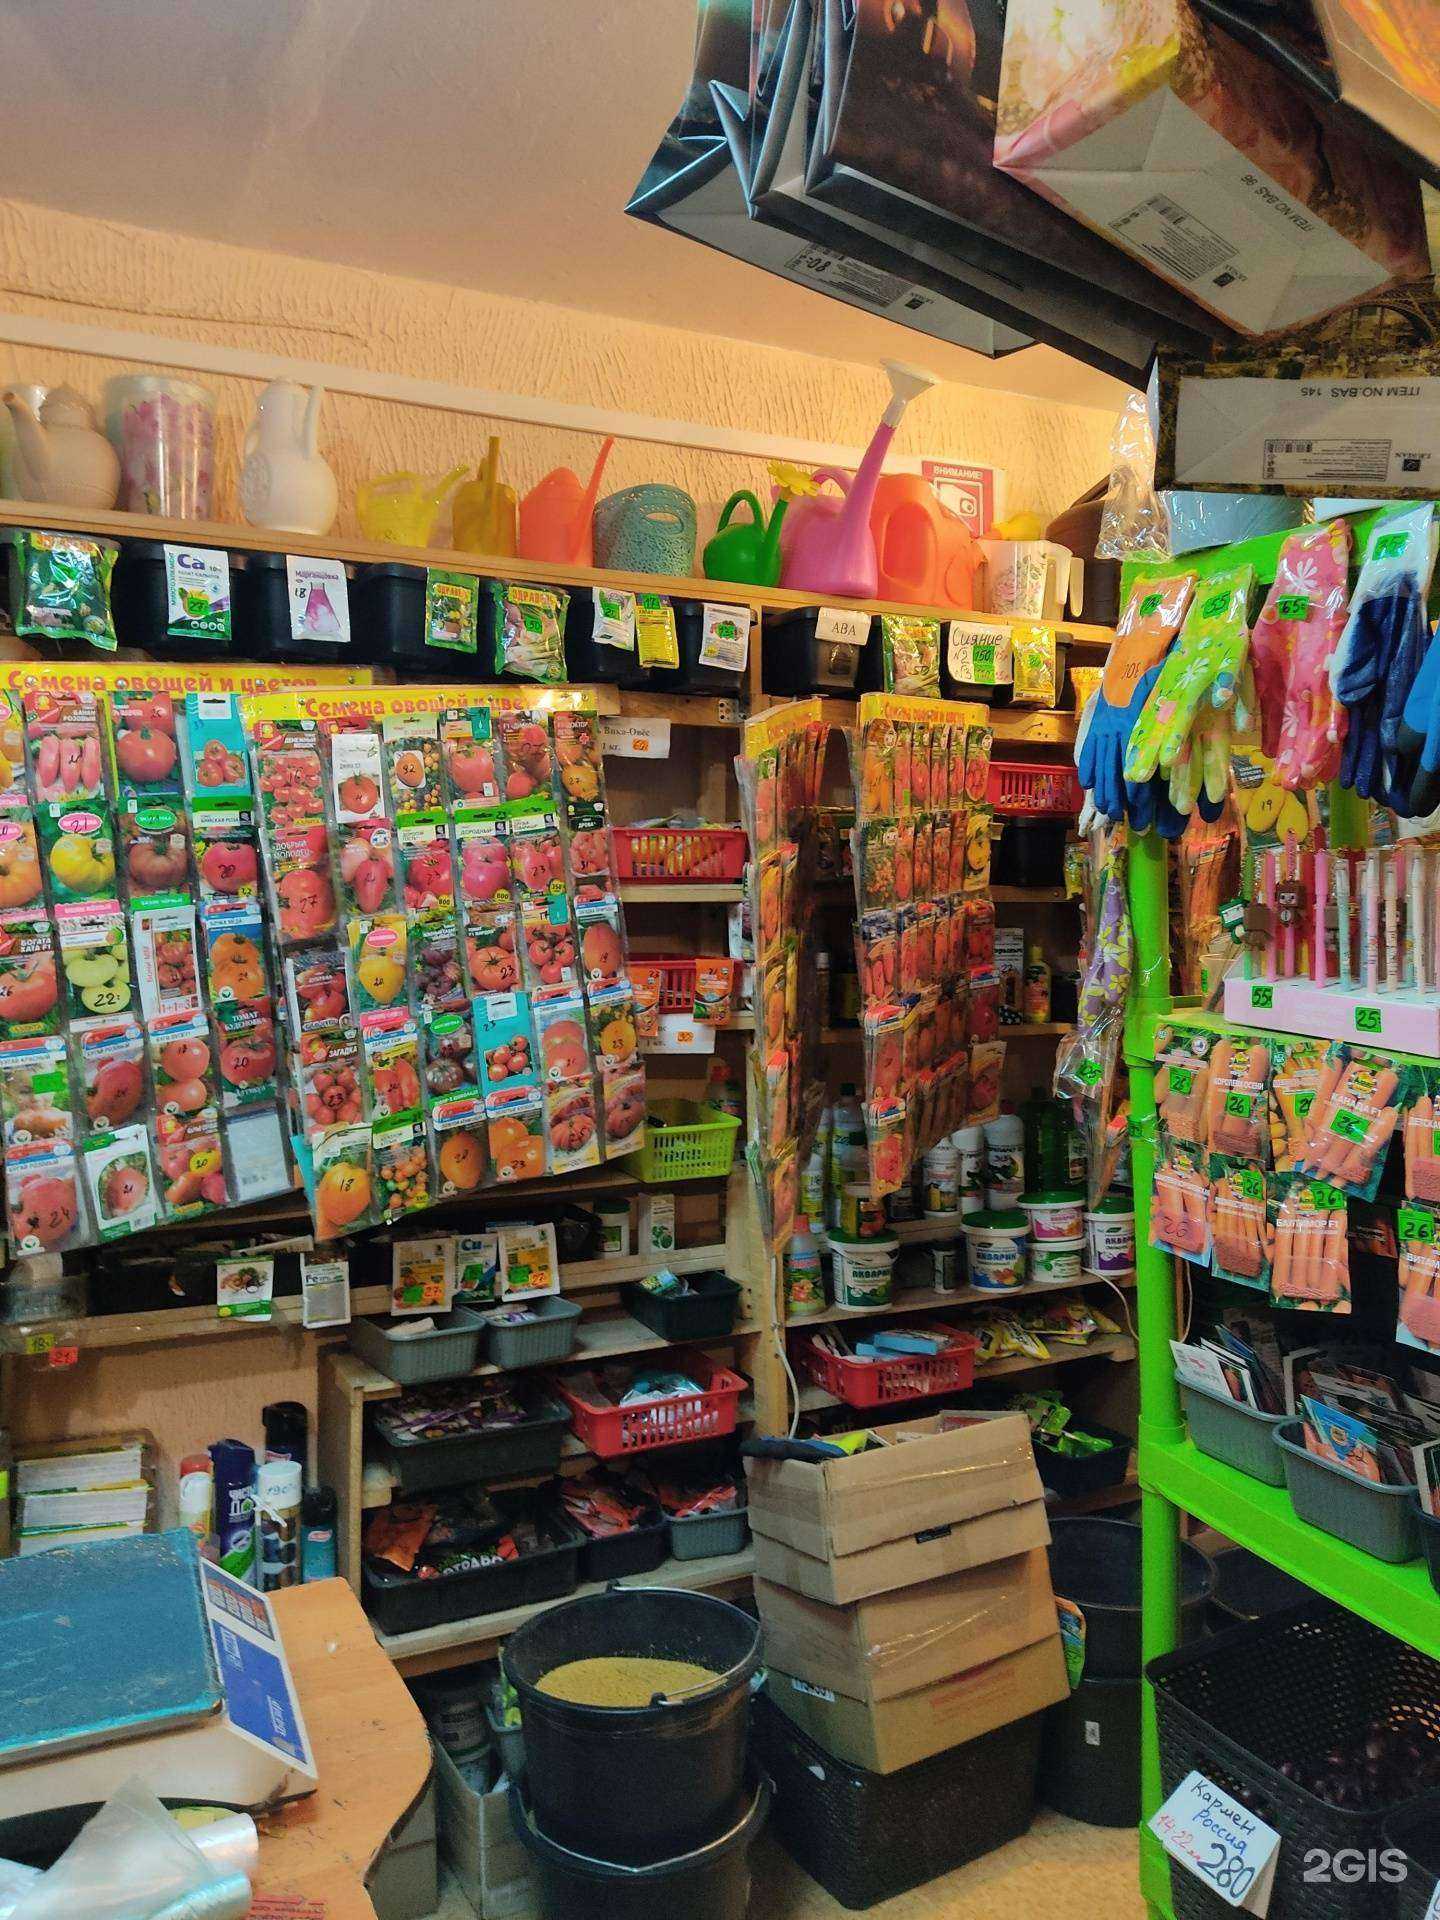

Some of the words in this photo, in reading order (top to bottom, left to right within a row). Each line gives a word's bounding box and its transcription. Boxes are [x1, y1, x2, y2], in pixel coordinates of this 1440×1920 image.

[1300, 387, 1323, 397] 145
[1386, 386, 1421, 397] ITEM
[952, 626, 1003, 646] Сияние
[8, 670, 106, 692] Семена
[114, 671, 212, 694] овощей
[219, 677, 234, 692] и
[305, 697, 385, 718] Семена
[392, 692, 469, 713] овощей
[233, 1011, 259, 1022] ТОМАТ
[329, 1045, 358, 1058] ЗАГАДКА
[1228, 1096, 1245, 1114] 26
[1316, 1190, 1338, 1206] 26
[1404, 1222, 1430, 1239] 26
[1190, 1779, 1257, 1838] Кармен
[1192, 1810, 1249, 1857] Россия
[1196, 1842, 1256, 1899] 280
